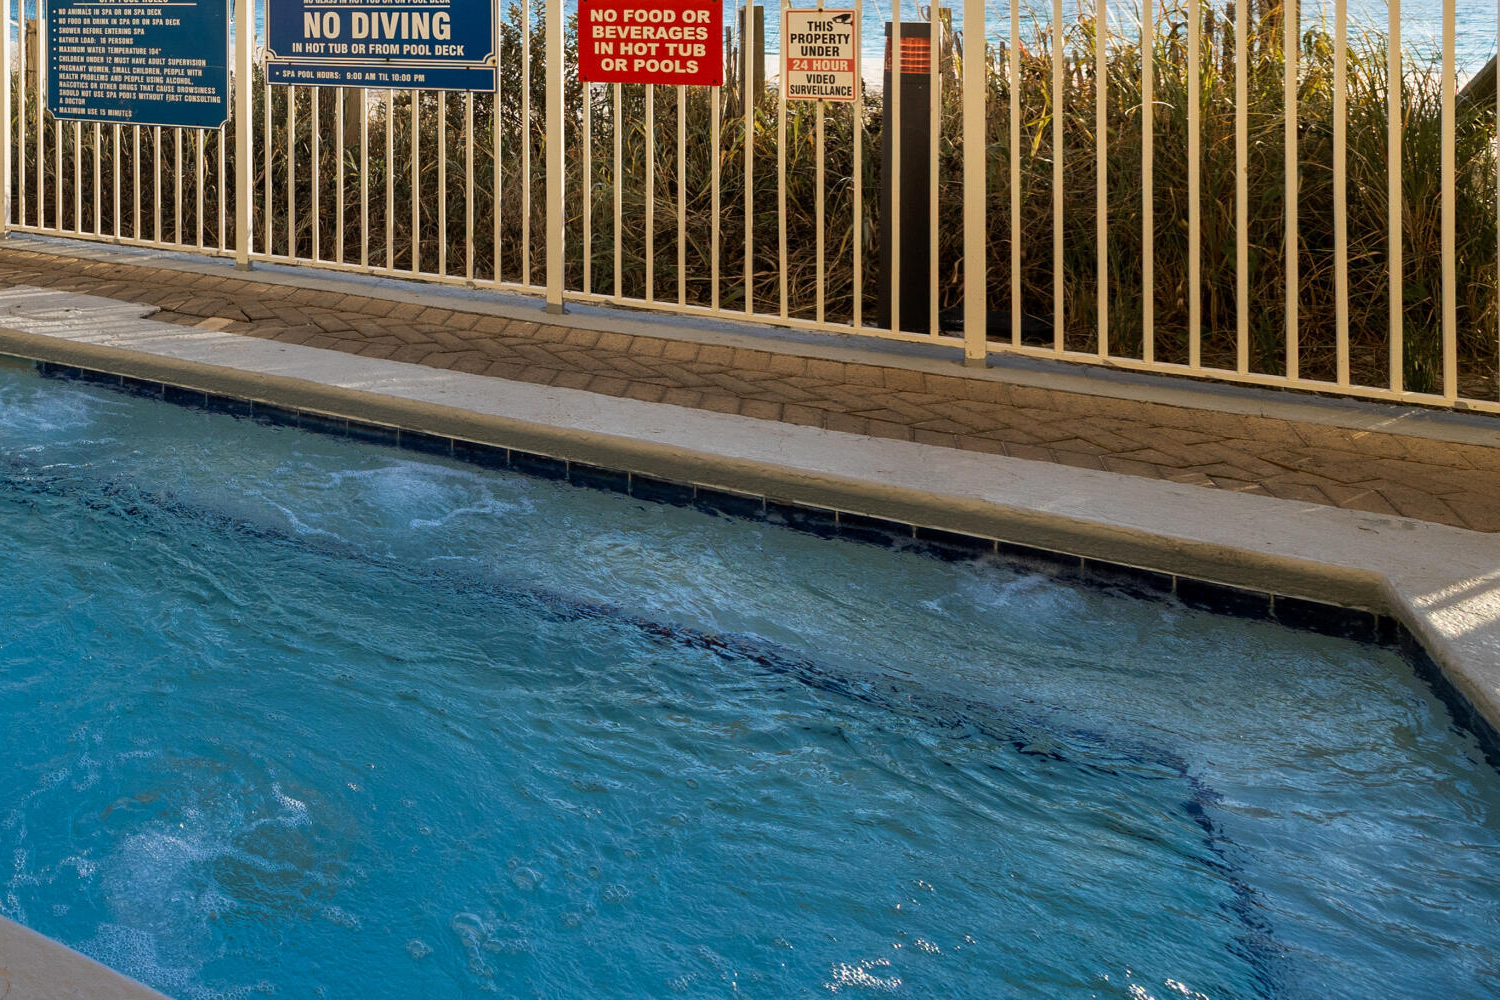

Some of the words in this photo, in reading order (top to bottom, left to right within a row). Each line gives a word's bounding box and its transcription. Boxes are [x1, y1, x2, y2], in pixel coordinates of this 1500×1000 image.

[590, 9, 617, 22] NO
[624, 10, 676, 23] FOOD
[682, 10, 711, 23] OR
[304, 12, 341, 39] NO
[352, 12, 451, 40] DIVING
[807, 21, 834, 32] THIS
[593, 26, 708, 41] BEVERAGES
[791, 34, 850, 44] PROPERTY
[292, 43, 302, 53] IN
[306, 43, 325, 53] HOT
[328, 44, 348, 54] TUB
[352, 44, 366, 54] OR
[369, 44, 400, 55] FROM
[403, 45, 432, 55] POOL
[435, 45, 464, 56] DECK
[595, 42, 614, 55] IN
[620, 43, 660, 56] HOT
[665, 43, 706, 57] TUB
[801, 46, 840, 57] UNDER
[601, 58, 628, 72] OR
[634, 59, 699, 74] POOLS
[793, 60, 808, 70] 24
[813, 60, 848, 71] HOUR
[282, 70, 295, 78] SPA
[378, 73, 390, 81] TIL
[392, 74, 411, 82] 10:00
[414, 74, 425, 82] PM
[806, 74, 836, 85] VIDEO
[790, 85, 852, 96] SURVEILLANCE
